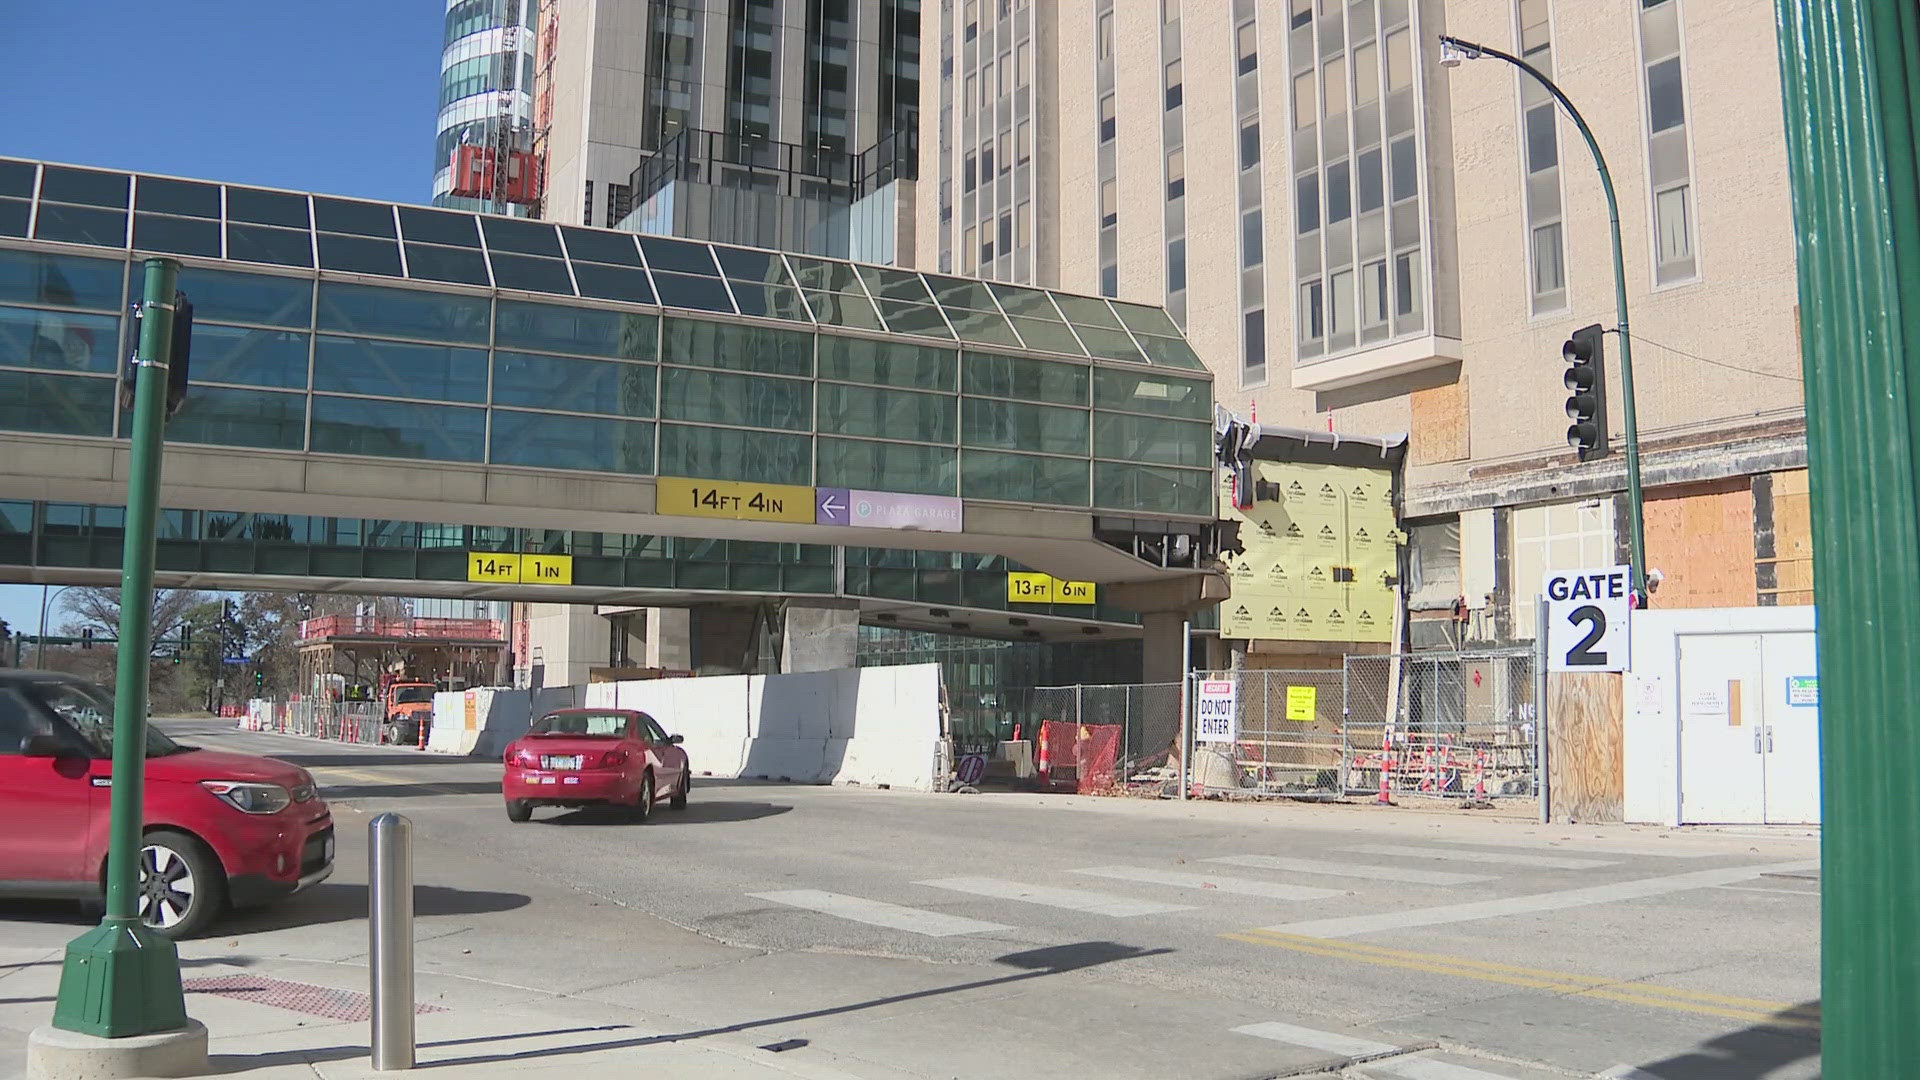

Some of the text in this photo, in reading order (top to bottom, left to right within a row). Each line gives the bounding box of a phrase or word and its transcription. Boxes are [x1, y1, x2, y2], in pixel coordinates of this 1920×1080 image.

[876, 505, 910, 517] PLAZA
[914, 507, 957, 520] GARAGE
[1548, 573, 1623, 601] GATE
[1566, 605, 1607, 665] 2
[1202, 699, 1231, 715] DO NOT
[1203, 718, 1229, 734] ENTER
